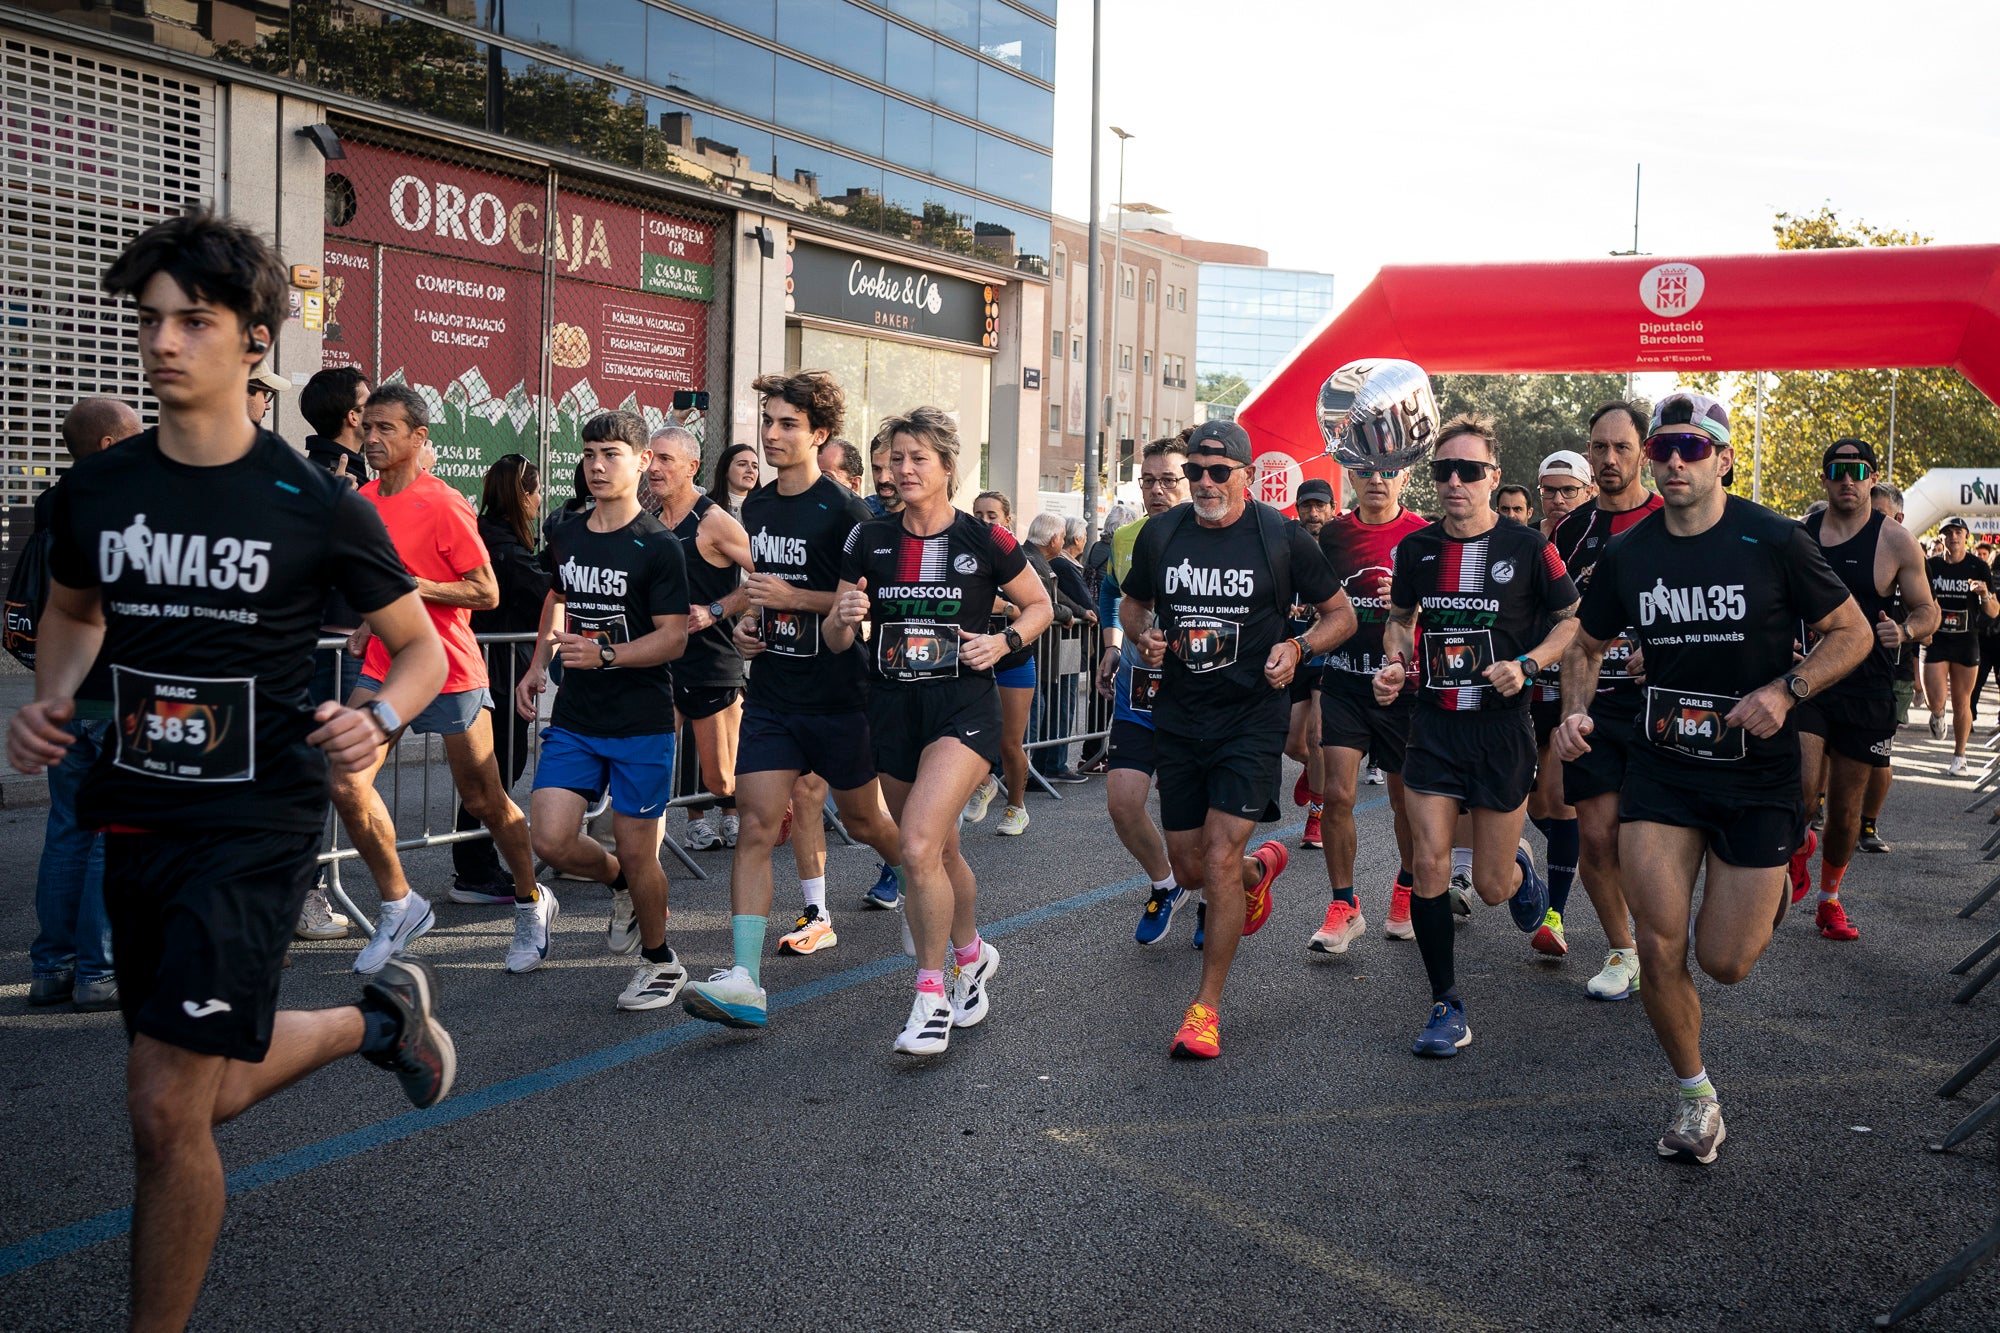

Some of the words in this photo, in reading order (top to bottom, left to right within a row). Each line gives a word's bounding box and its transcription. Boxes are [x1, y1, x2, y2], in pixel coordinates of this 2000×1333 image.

[389, 174, 612, 272] OROCAJA
[649, 220, 704, 245] COMPREM
[668, 240, 685, 256] OR
[655, 263, 681, 280] CASA
[684, 269, 698, 284] DE
[415, 274, 484, 299] COMPREM
[486, 285, 506, 302] OR
[849, 259, 900, 303] Cookie
[902, 276, 914, 304] &
[1639, 320, 1704, 334] Diputació
[431, 329, 449, 344] DEL
[1640, 335, 1704, 345] Barcelona
[466, 446, 482, 461] DE
[1974, 521, 2000, 530] ARRI
[878, 586, 962, 600] AUTOESCOLA
[162, 604, 190, 617] PAU
[582, 602, 596, 610] PAU
[880, 599, 962, 617] STILO
[1174, 604, 1198, 613] CURSA
[1199, 606, 1215, 614] PAU
[1216, 605, 1250, 614] DINARÈS
[1422, 596, 1500, 612] AUTOESCOLA
[581, 621, 600, 630] MARC
[775, 620, 796, 637] 786
[1179, 619, 1196, 628] JOSÉ
[1197, 620, 1223, 628] JAVIER
[904, 627, 936, 636] SUSANA
[1652, 635, 1684, 646] CURSA
[1685, 634, 1701, 643] PAU
[1703, 631, 1745, 643] DINARÈS
[1191, 638, 1208, 653] 81
[1444, 637, 1465, 645] JORDI
[905, 645, 930, 661] 45
[1447, 655, 1465, 669] 16
[154, 684, 197, 699] MARC
[1679, 697, 1714, 708] CARLES
[146, 712, 207, 745] 383
[1677, 717, 1713, 738] 184
